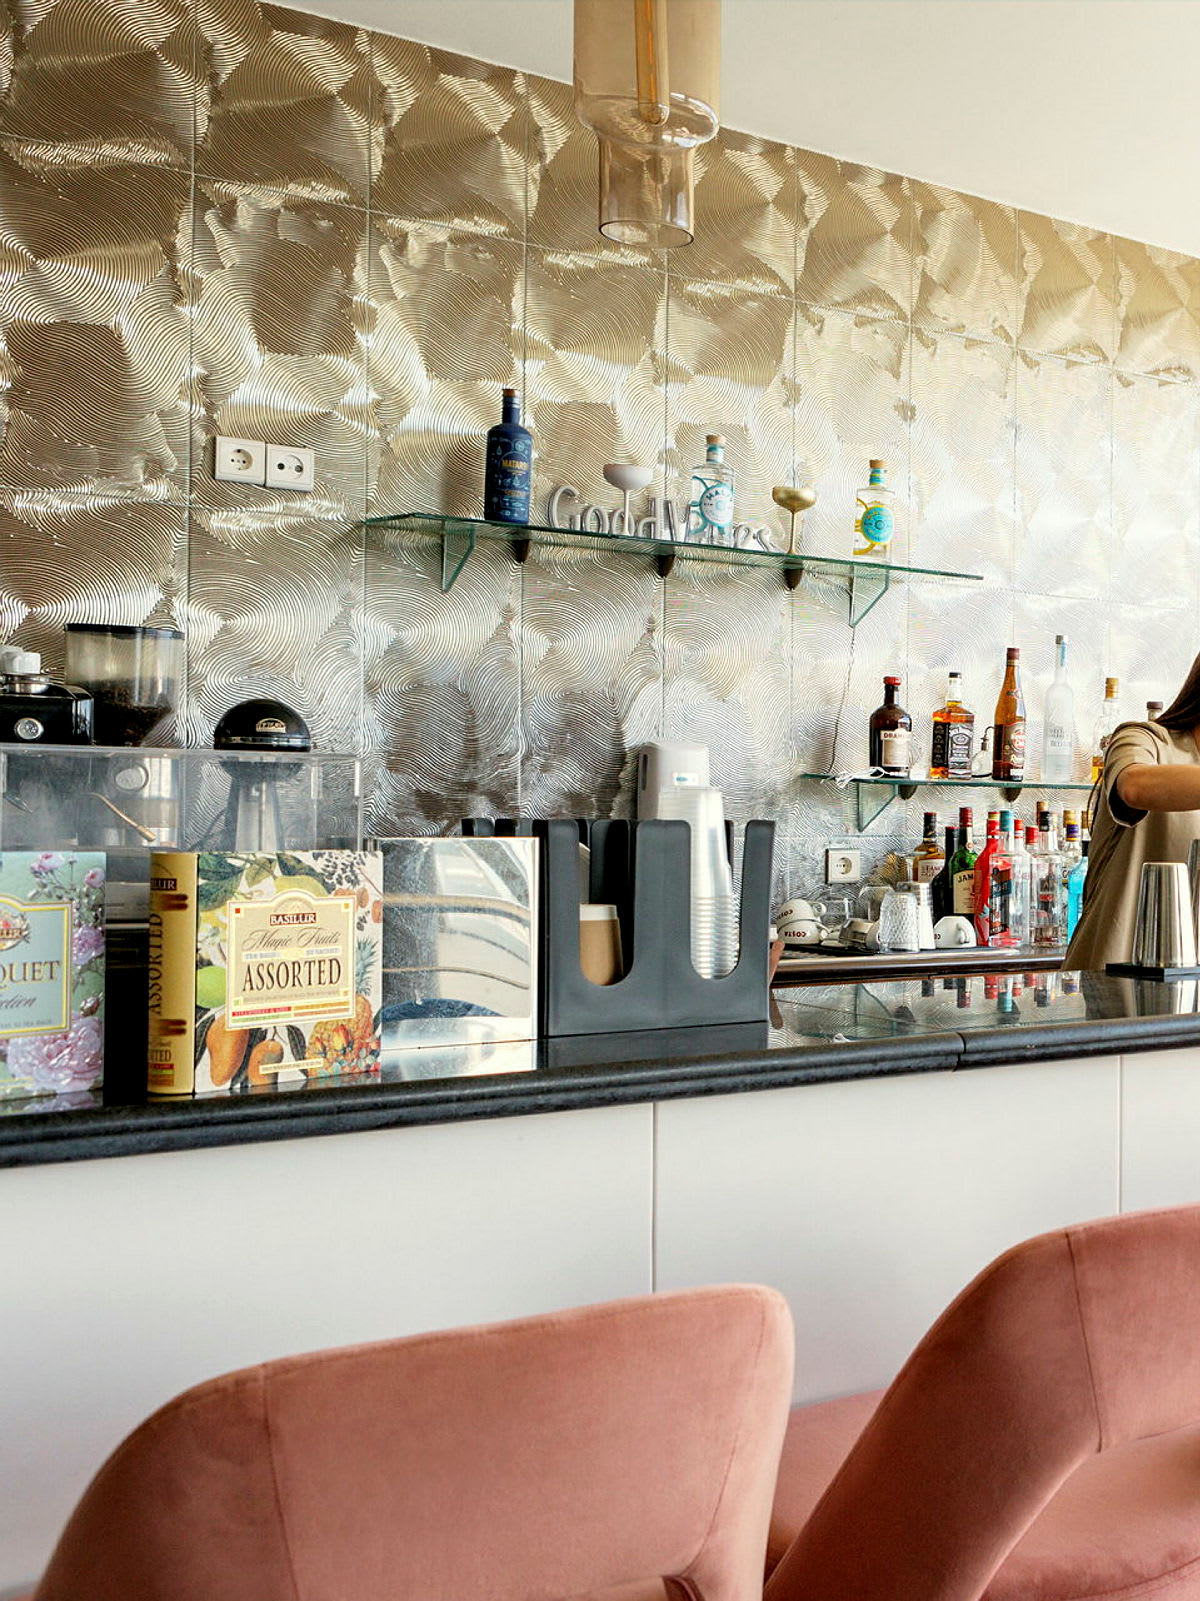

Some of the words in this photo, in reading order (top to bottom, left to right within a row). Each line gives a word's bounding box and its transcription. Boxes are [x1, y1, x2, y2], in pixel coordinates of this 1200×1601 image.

[547, 484, 667, 542] Good
[271, 913, 316, 924] BASILUR
[243, 928, 292, 951] Magic
[297, 926, 341, 948] Fruits
[784, 930, 807, 938] COSTA
[242, 957, 342, 992] ASSORTED
